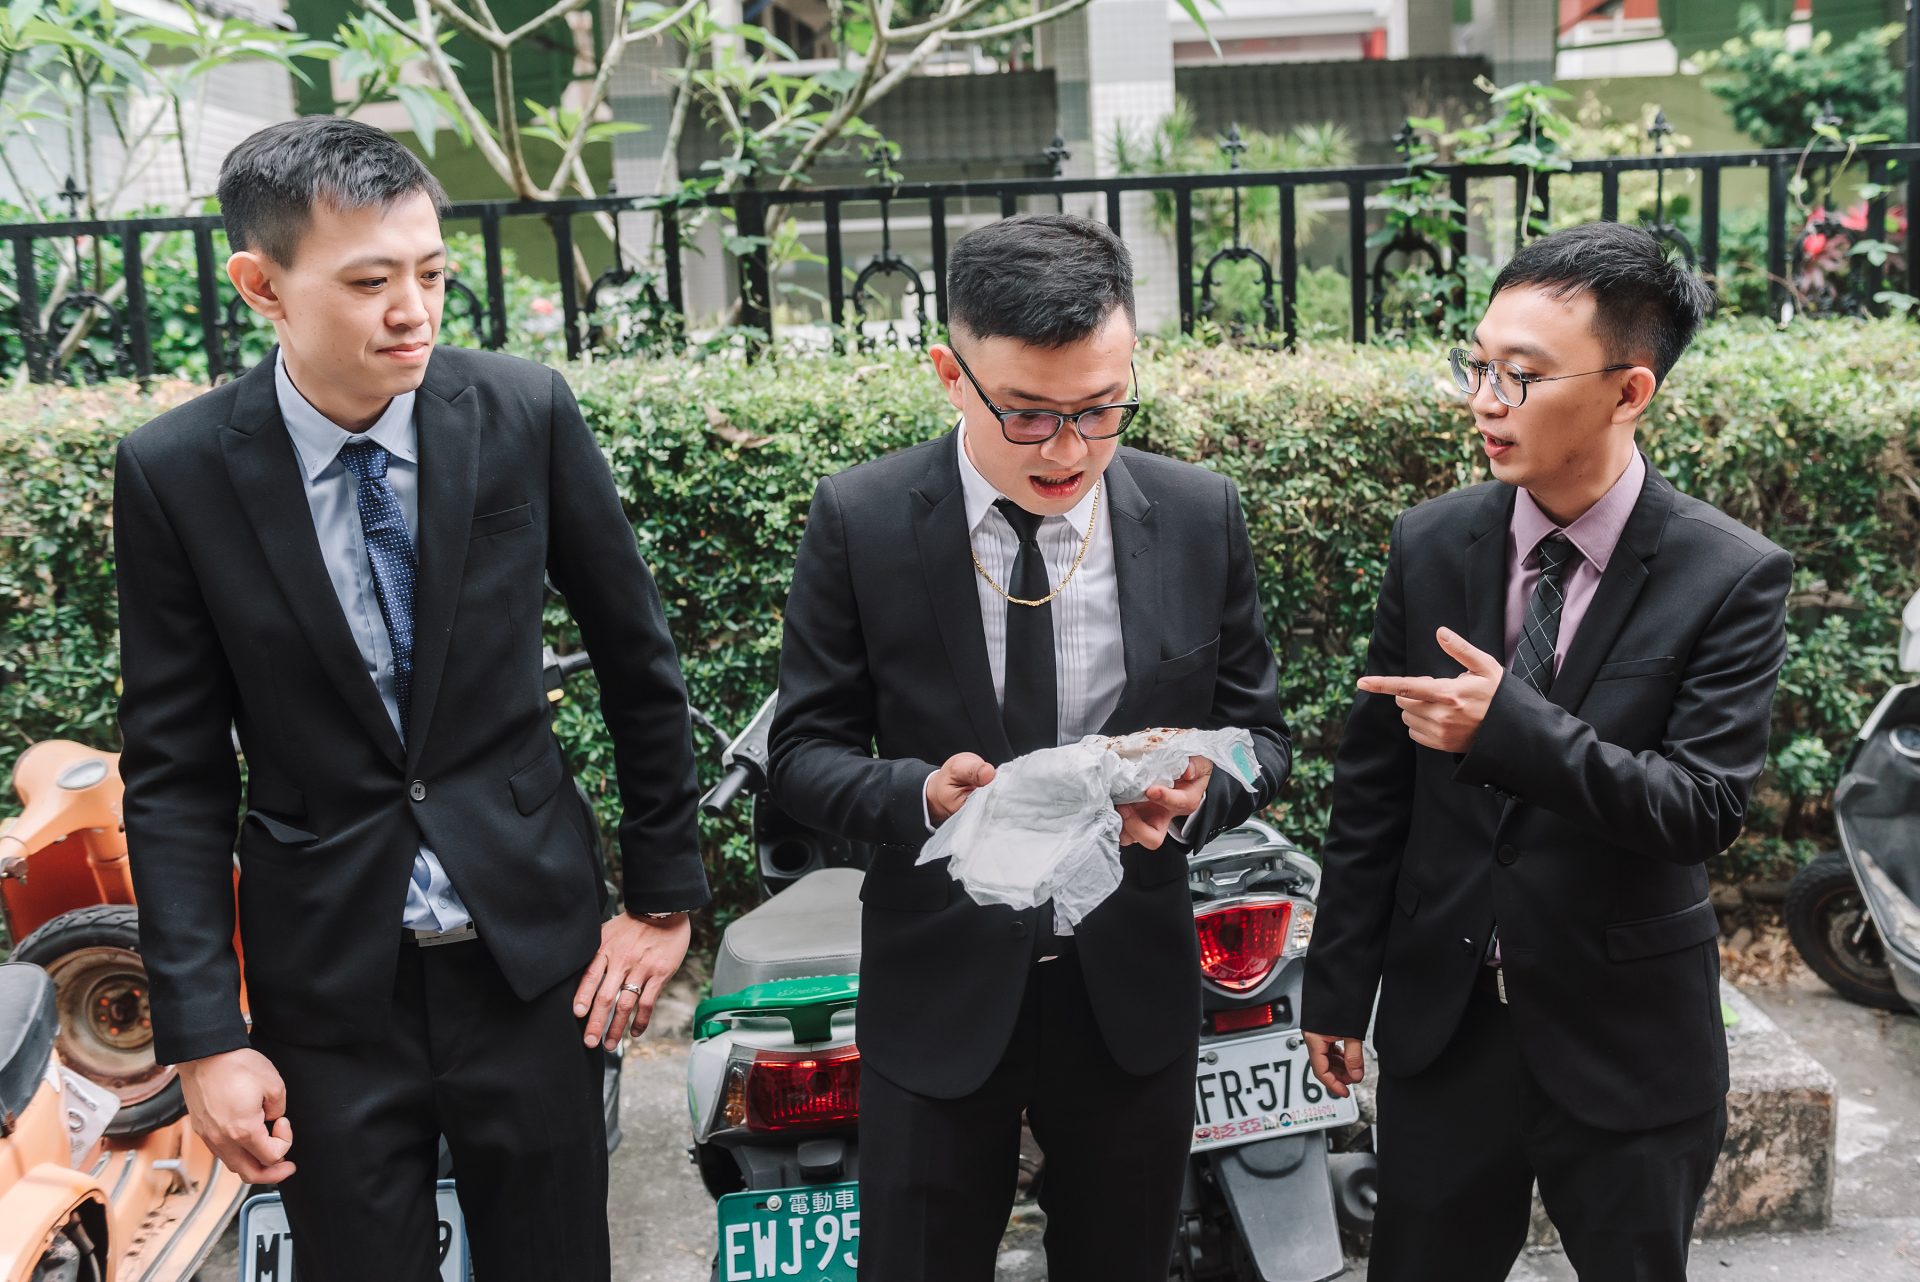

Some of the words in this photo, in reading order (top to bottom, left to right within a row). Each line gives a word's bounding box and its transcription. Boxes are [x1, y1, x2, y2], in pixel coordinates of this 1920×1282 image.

[1195, 1059, 1341, 1126] FR-576
[789, 1190, 855, 1215] 電動車
